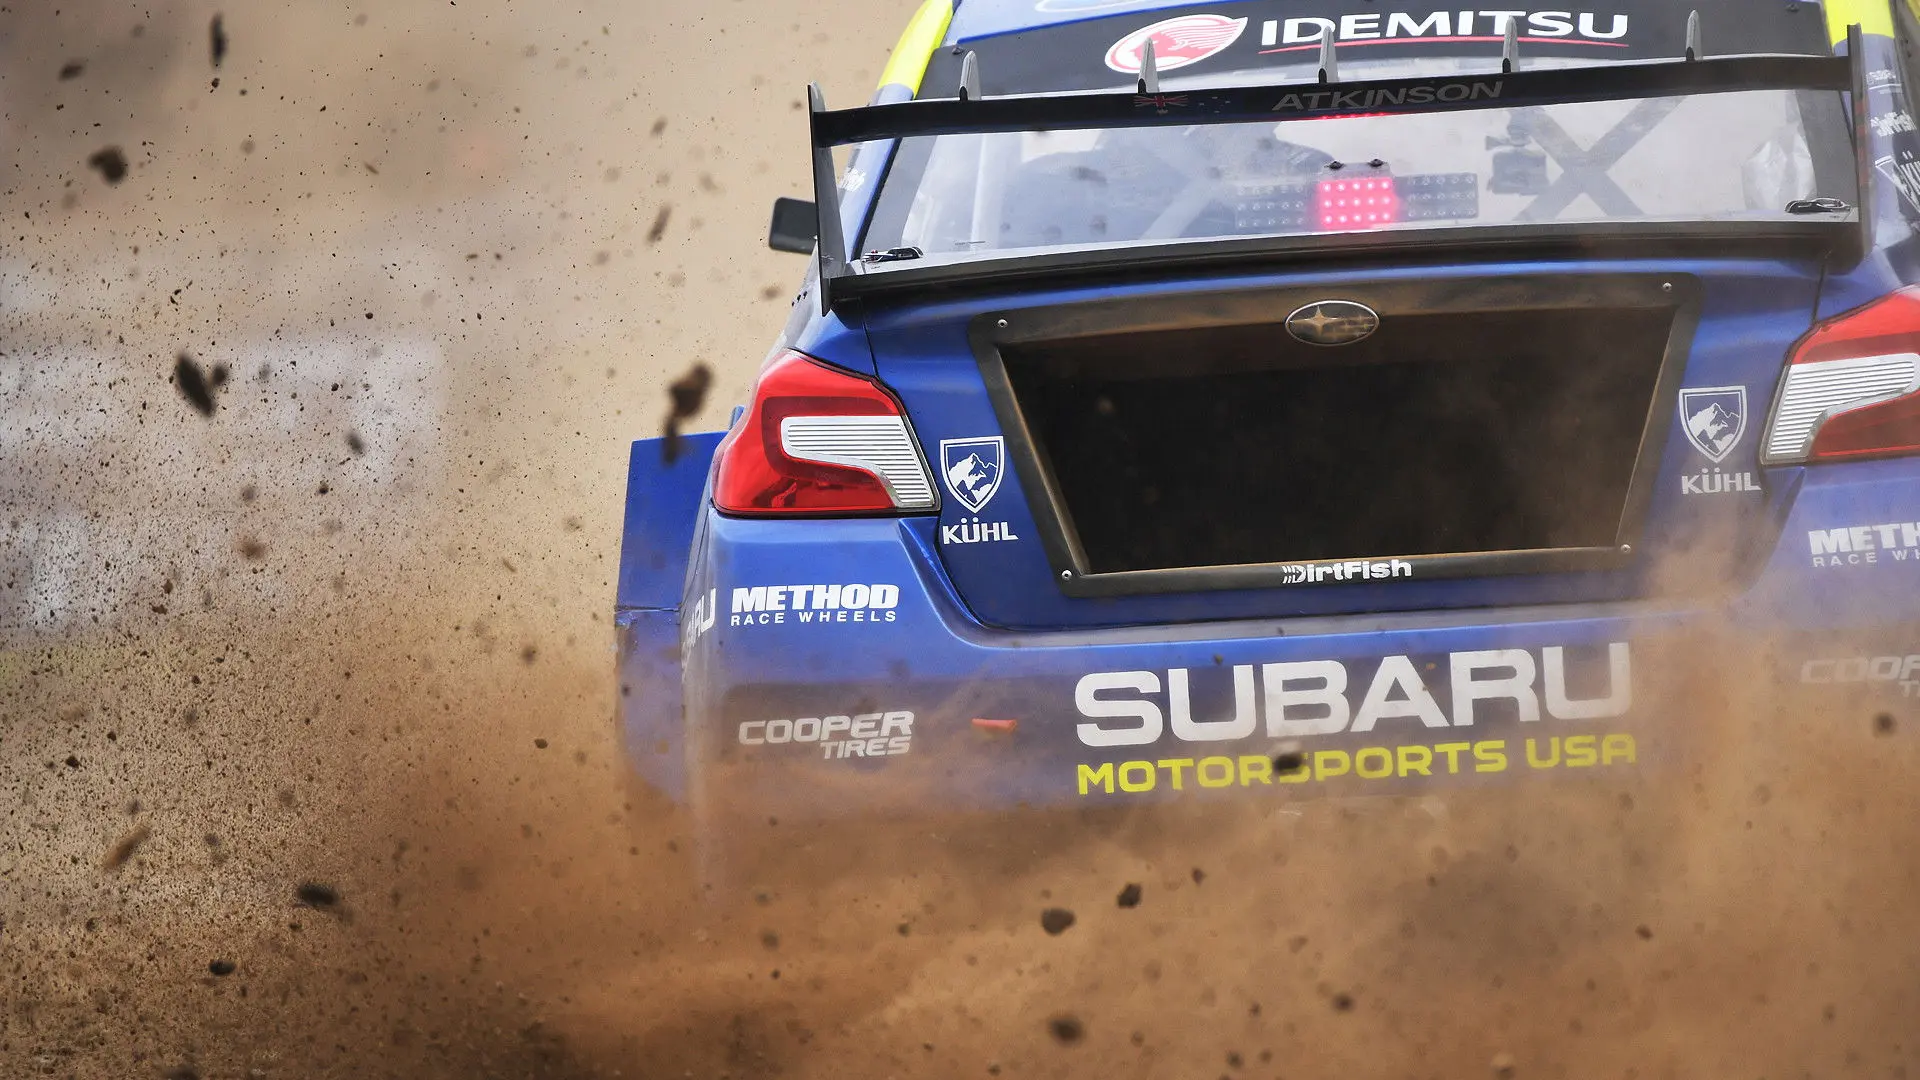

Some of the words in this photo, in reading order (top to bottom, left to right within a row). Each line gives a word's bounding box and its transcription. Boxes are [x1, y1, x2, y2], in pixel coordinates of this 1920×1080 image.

[1261, 10, 1628, 46] IDEMITSU
[1271, 81, 1504, 112] ATKINSON
[1681, 467, 1762, 494] KÜHL
[942, 516, 1019, 545] KÜHL
[1281, 559, 1412, 584] DirtFish
[1812, 552, 1878, 568] RACE
[731, 583, 900, 614] METHOD
[730, 612, 785, 627] RACE
[799, 610, 897, 624] WHEELS
[1075, 642, 1632, 747] SUBARU
[738, 710, 915, 745] COOPER
[820, 736, 912, 760] TIRES
[1525, 733, 1636, 769] USA
